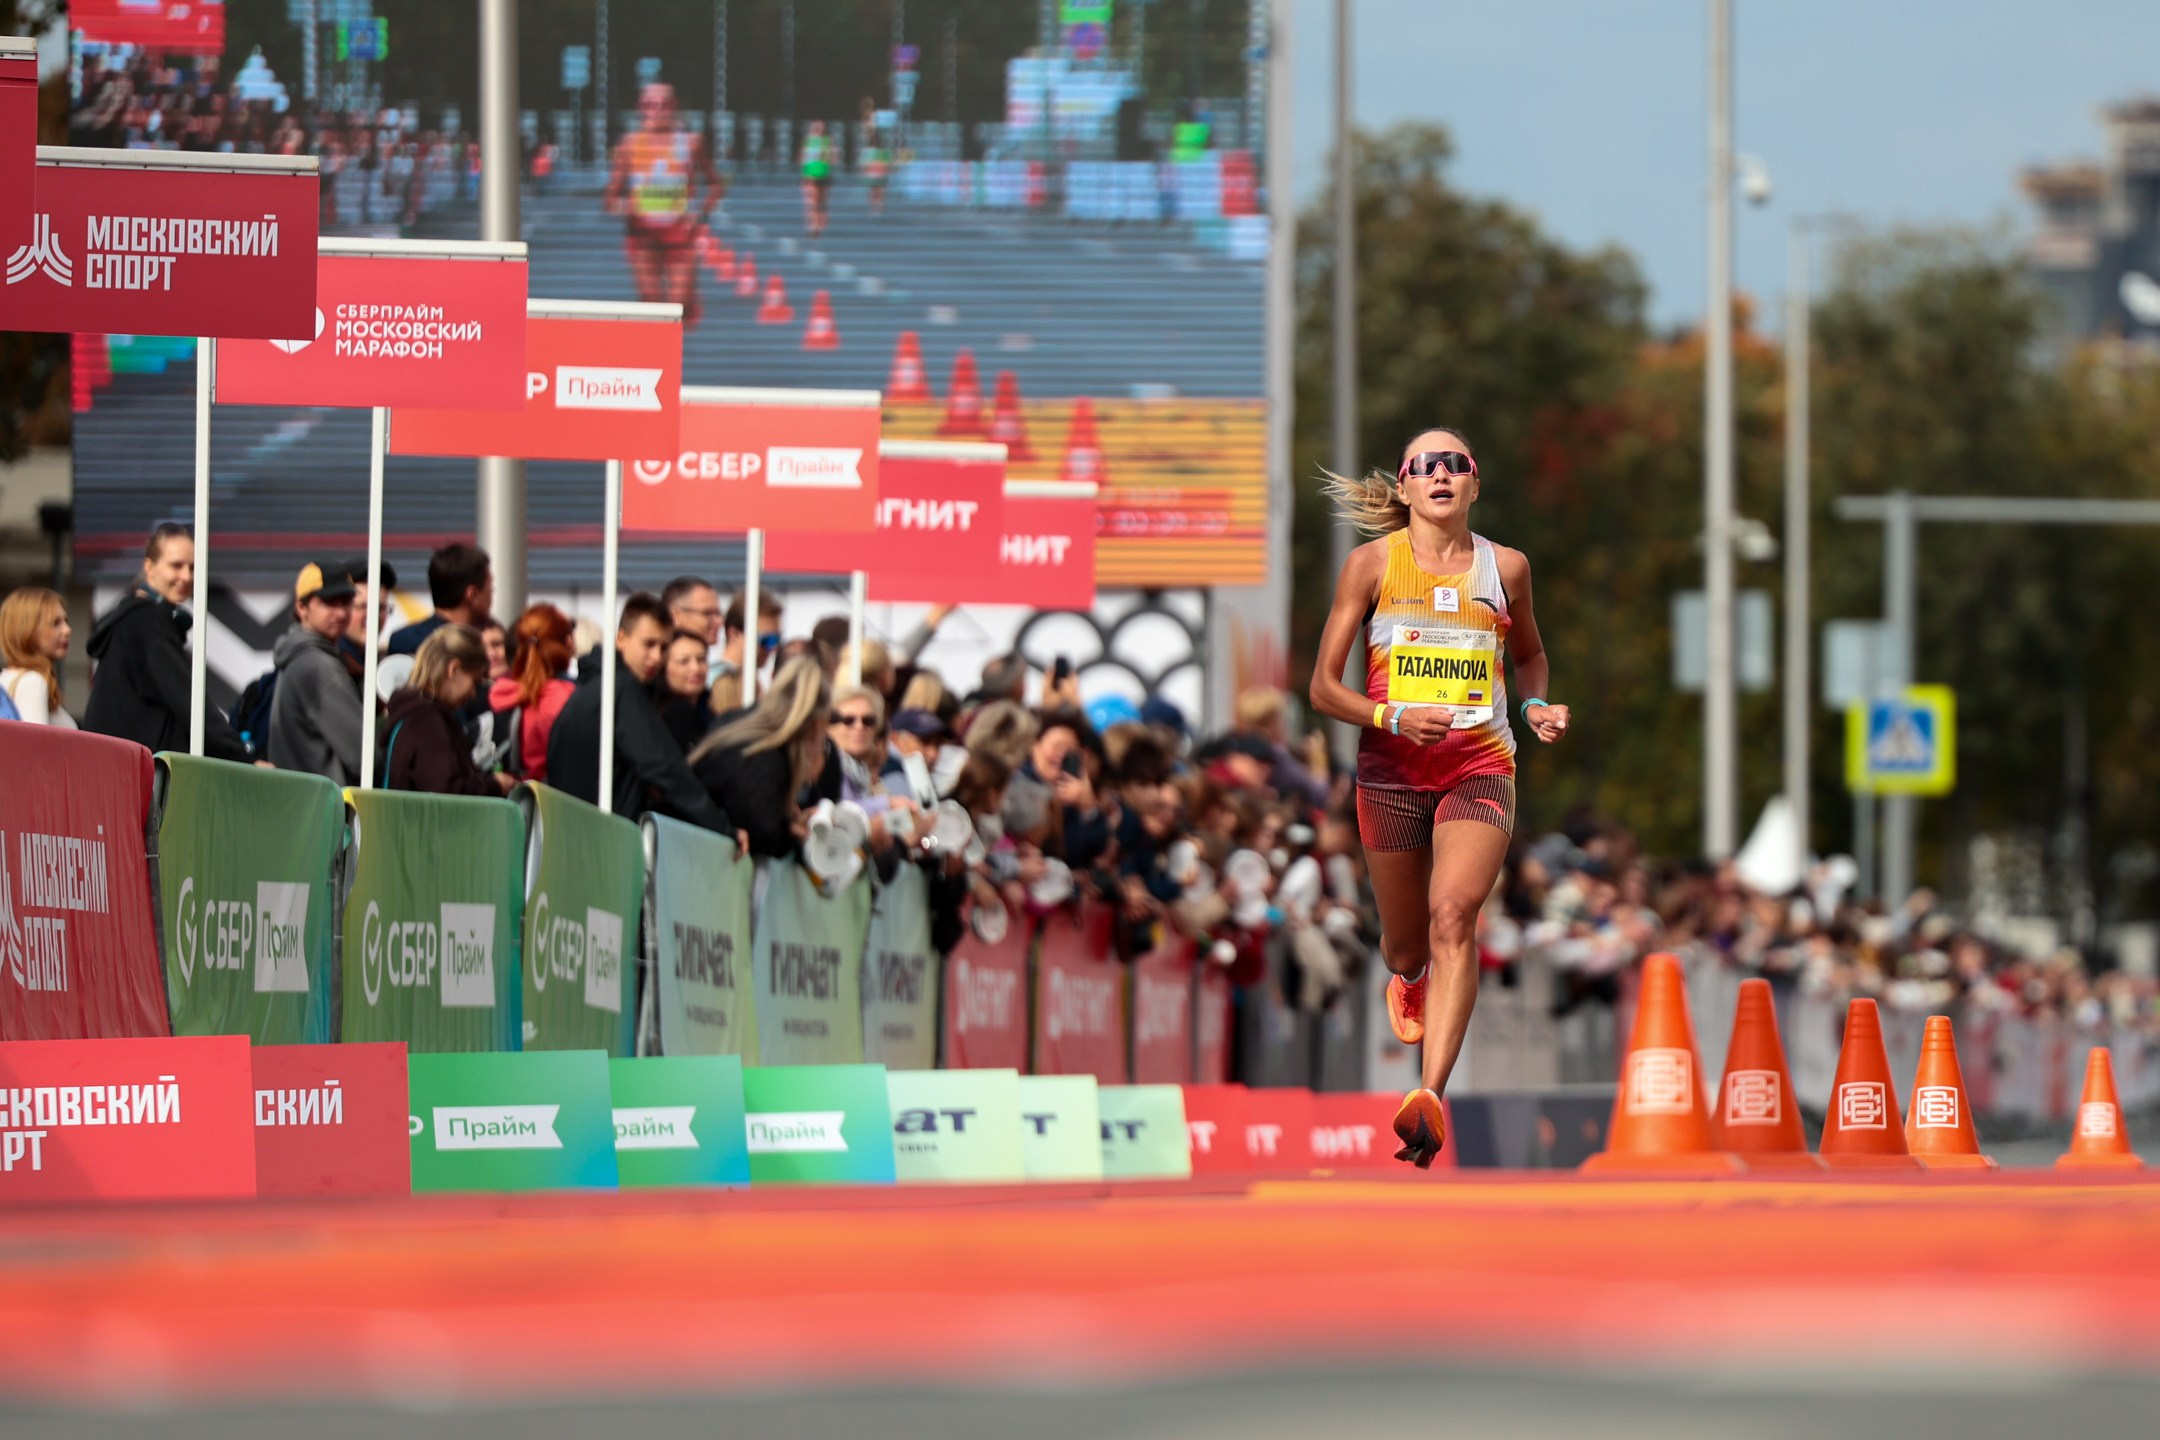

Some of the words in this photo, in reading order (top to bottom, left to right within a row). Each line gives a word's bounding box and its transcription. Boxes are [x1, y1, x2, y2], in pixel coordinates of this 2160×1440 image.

[86, 214, 279, 257] МОСКОВСКИЙ
[86, 253, 176, 291] СПОРТ
[336, 303, 443, 320] СБЕРПРАЙМ
[335, 319, 482, 342] МОСКОВСКИЙ
[335, 339, 443, 359] МАРАФОН
[567, 375, 641, 400] Прайм
[677, 450, 762, 480] СБЕР
[777, 456, 845, 477] Прайм
[1396, 655, 1488, 681] TATARINOVA
[1436, 689, 1448, 699] 26
[203, 899, 252, 970] СБЕР
[387, 920, 437, 987] СБЕР
[447, 928, 486, 988] Прайм
[550, 915, 585, 983] СБЕР
[448, 1115, 536, 1140] Прайм
[750, 1120, 825, 1144] Прайм
[0, 1131, 48, 1171] РТ
